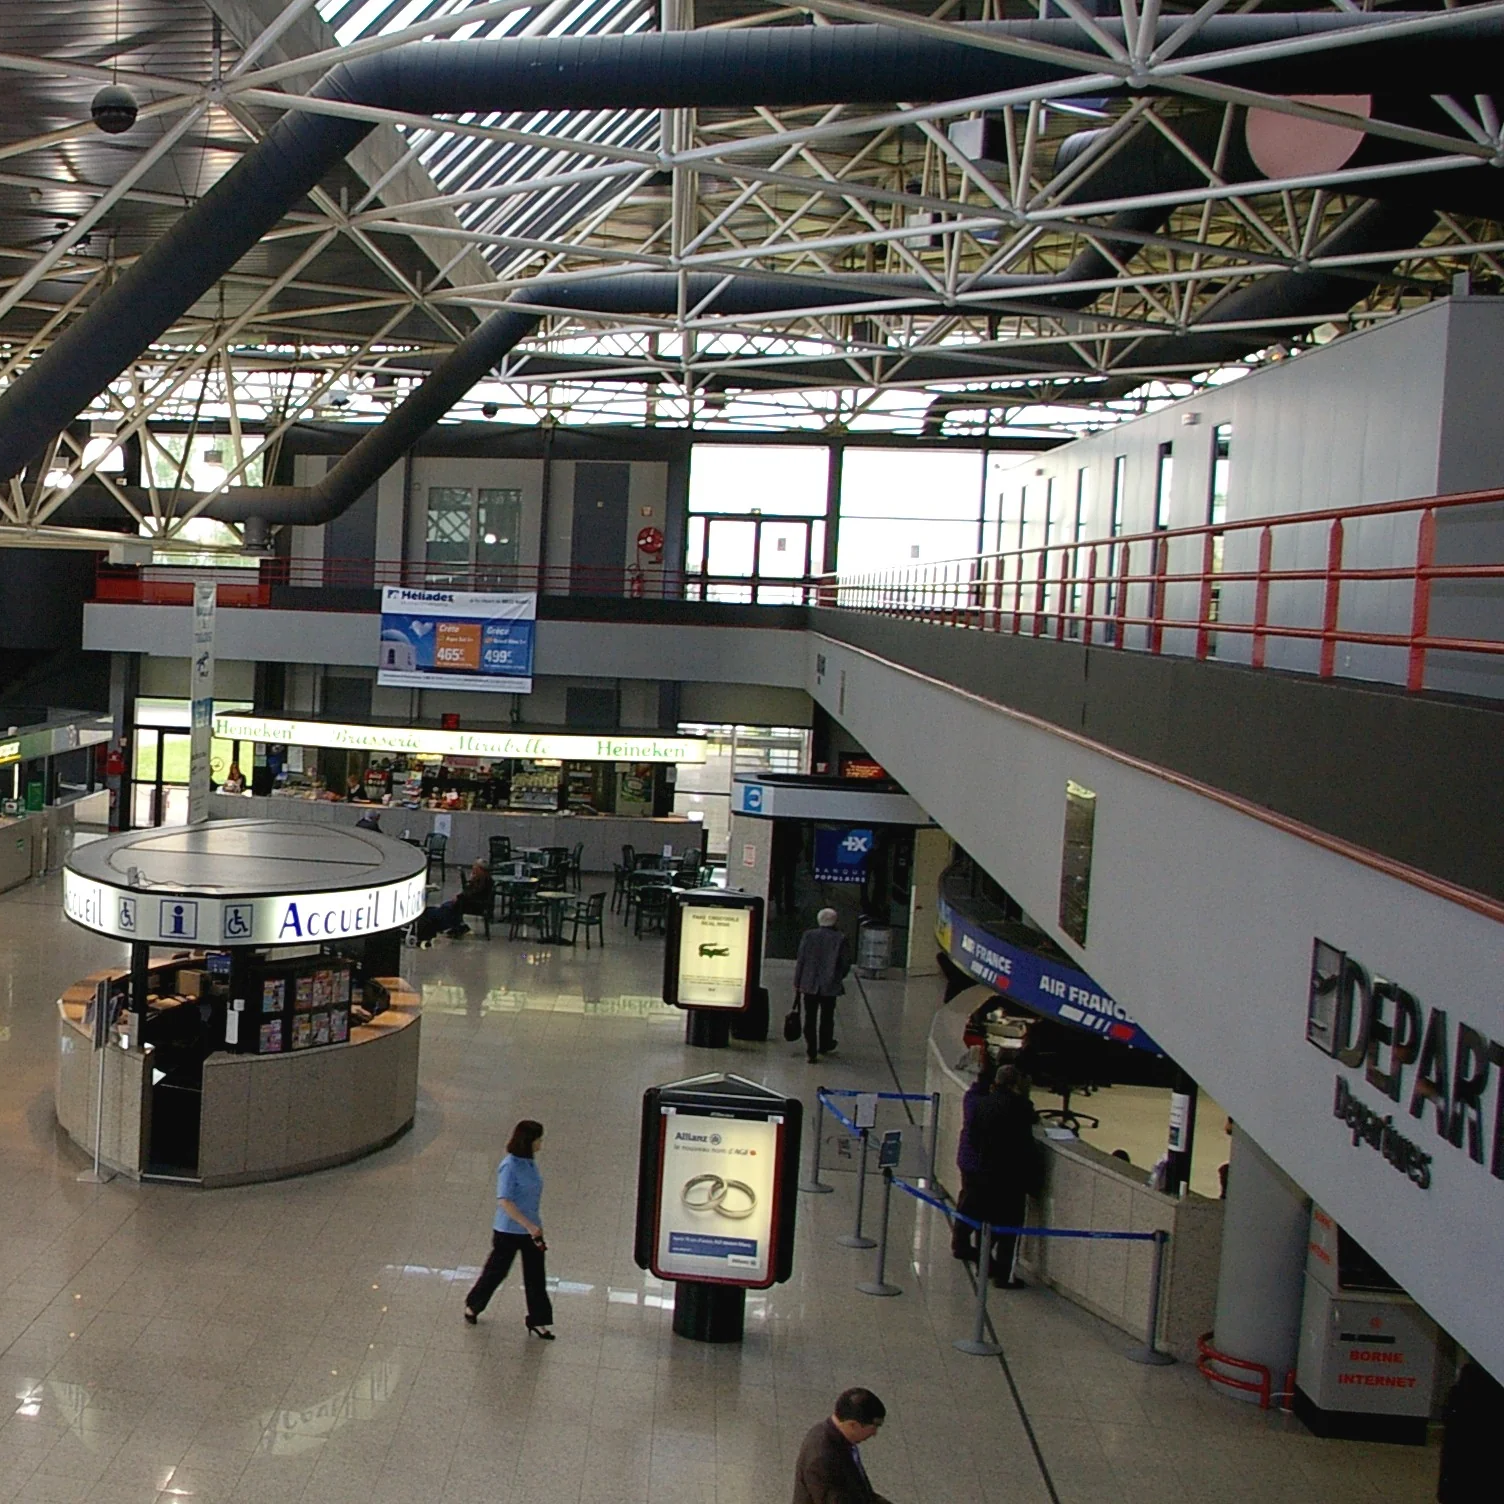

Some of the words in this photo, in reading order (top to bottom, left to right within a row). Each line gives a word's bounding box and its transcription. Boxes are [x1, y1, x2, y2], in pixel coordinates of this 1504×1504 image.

[597, 740, 687, 758] Heineken
[962, 934, 975, 954] AIR
[976, 944, 1012, 975] FRANCE
[1039, 975, 1066, 999] AIR
[1069, 986, 1136, 1024] FRANC
[675, 1132, 708, 1143] Allianz
[1349, 1350, 1404, 1364] BORNE
[1338, 1374, 1417, 1388] INTERNET
